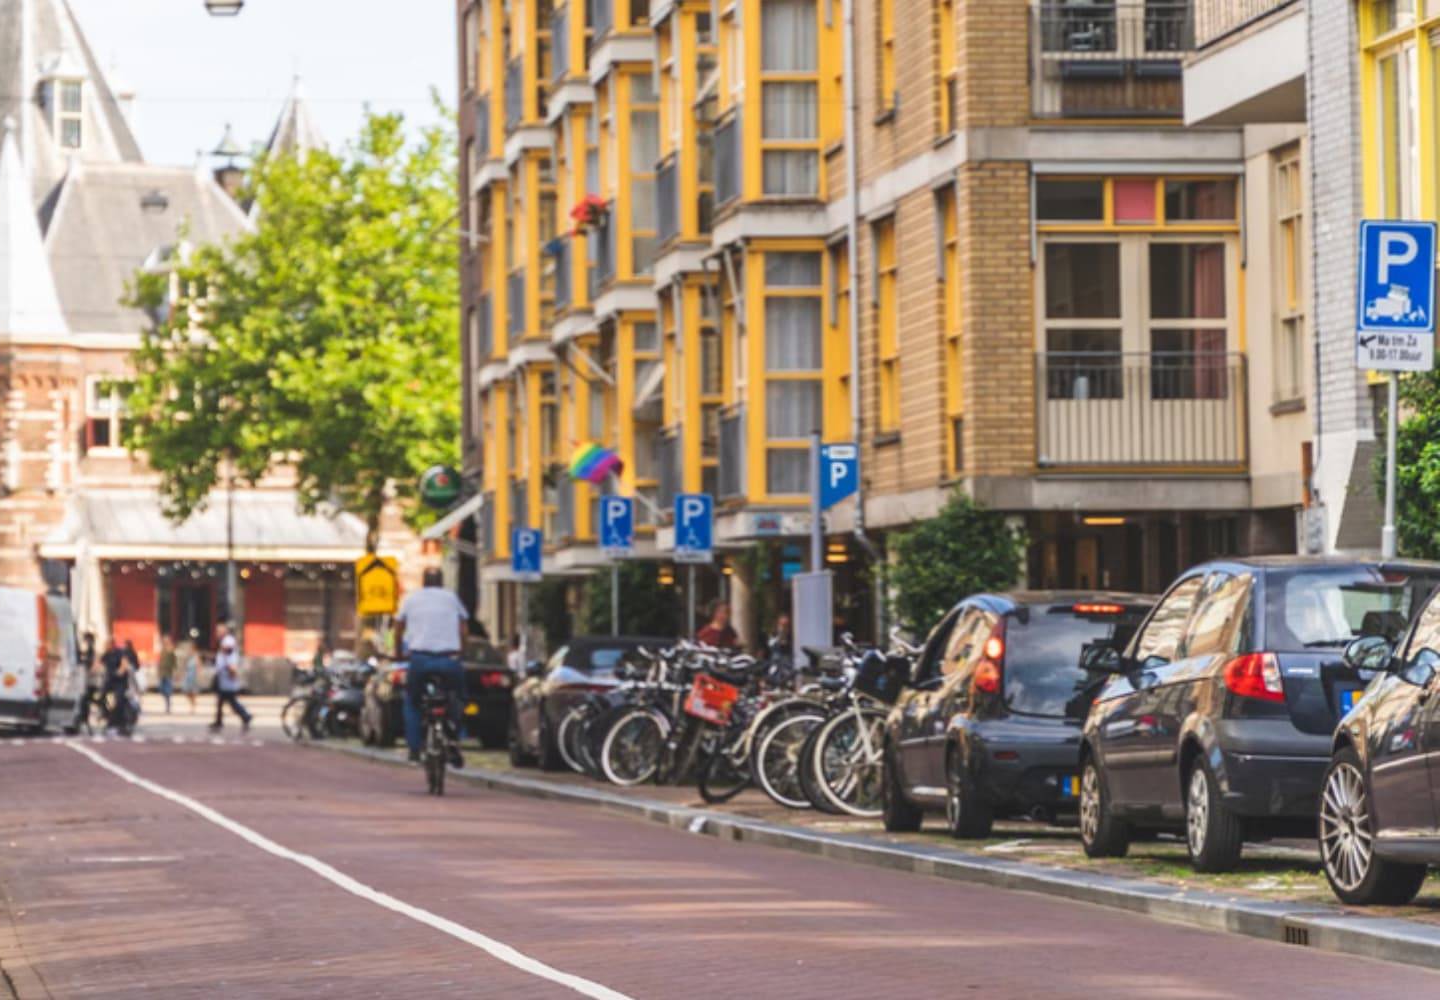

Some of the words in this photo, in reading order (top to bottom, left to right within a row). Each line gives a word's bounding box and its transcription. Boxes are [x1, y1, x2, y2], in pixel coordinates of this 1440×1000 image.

[1378, 231, 1418, 284] P
[830, 462, 848, 488] P
[607, 501, 626, 526] P
[683, 498, 704, 527] P
[518, 531, 536, 553] P
